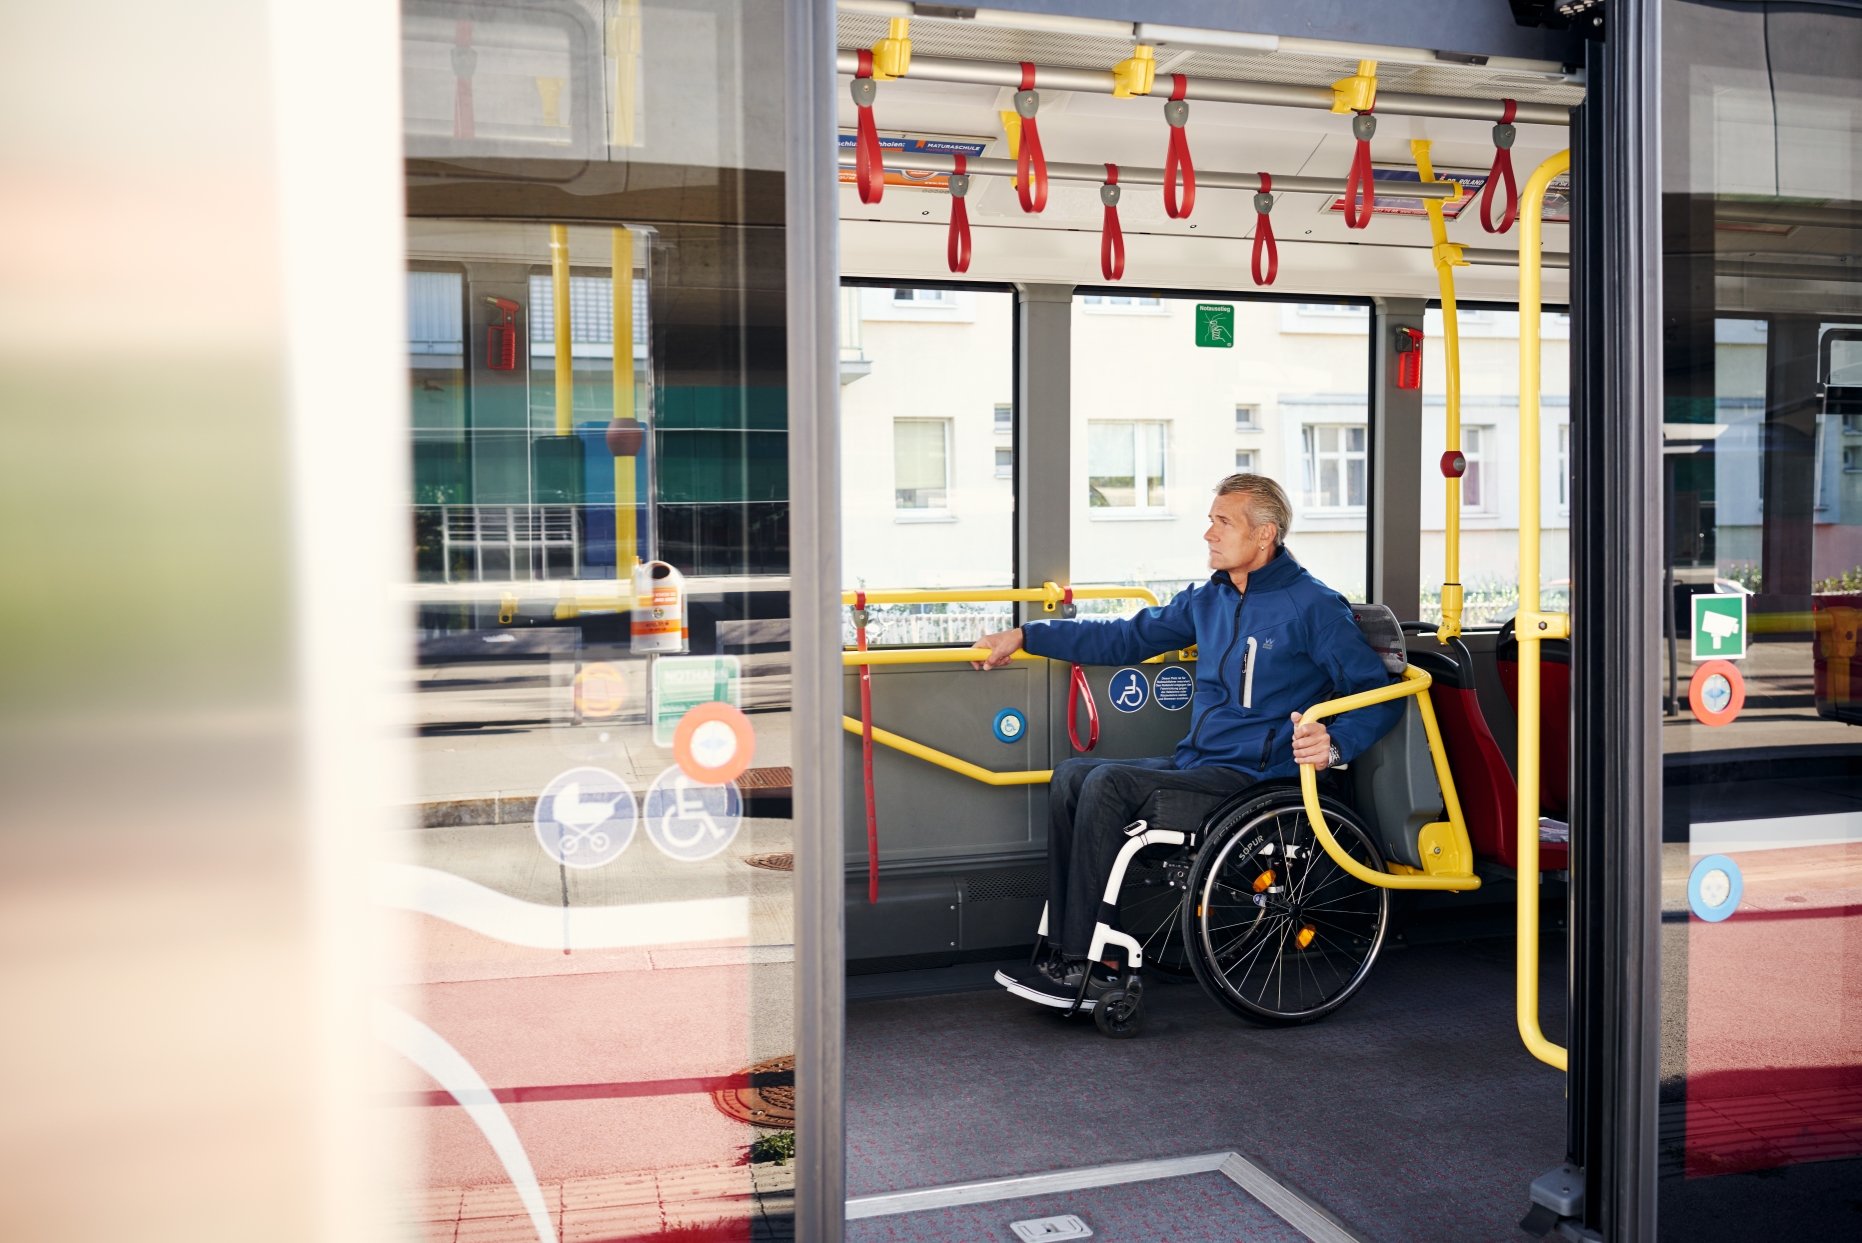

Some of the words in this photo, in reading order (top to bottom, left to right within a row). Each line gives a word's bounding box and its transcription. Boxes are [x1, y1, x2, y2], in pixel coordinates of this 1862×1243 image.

[927, 143, 981, 151] MATURASCHULE
[1458, 178, 1485, 186] ROLAND
[1199, 305, 1231, 313] Notausstieg
[1238, 835, 1264, 861] SOPUR
